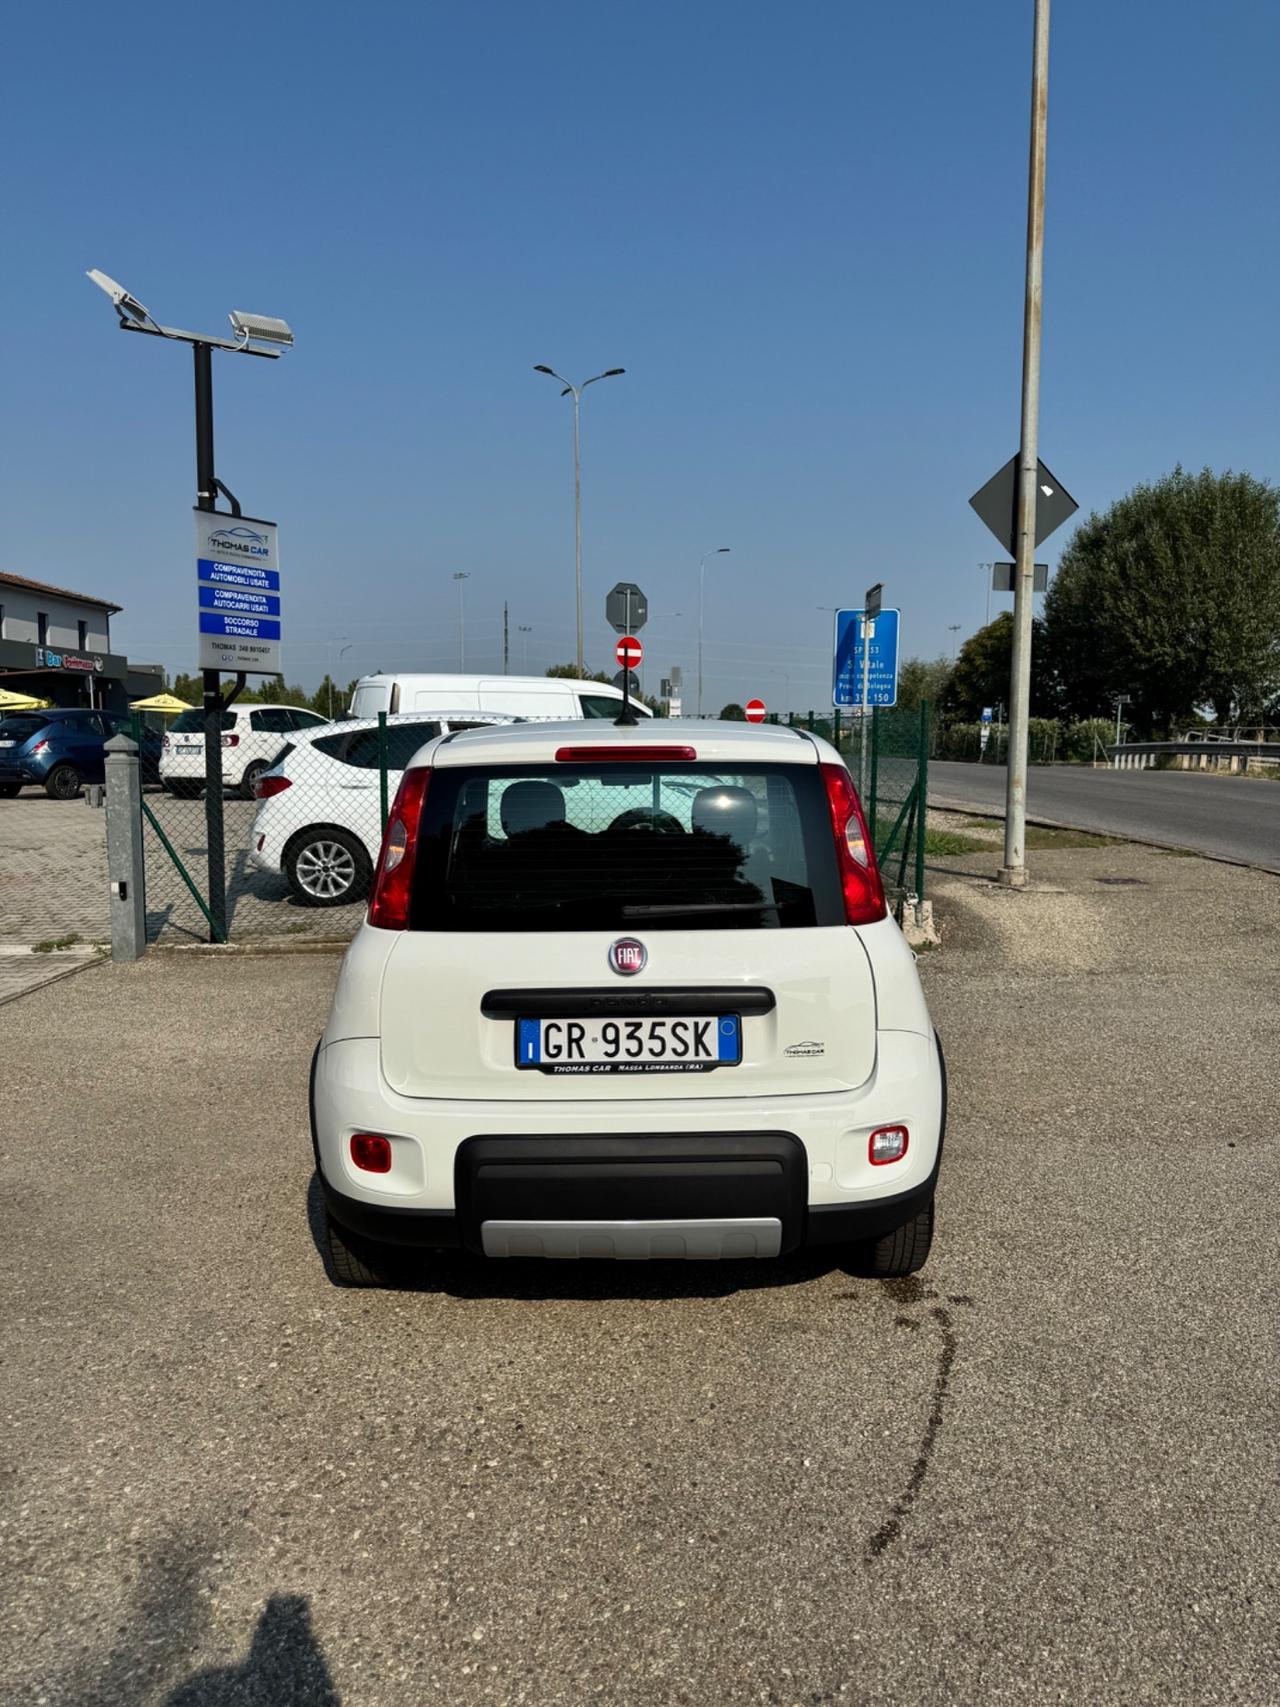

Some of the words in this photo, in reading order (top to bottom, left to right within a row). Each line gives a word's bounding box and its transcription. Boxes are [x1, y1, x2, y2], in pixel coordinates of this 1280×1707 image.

[211, 539, 249, 552] THOMAS
[250, 546, 269, 556] CAR
[213, 563, 266, 578] COMPRAVENDITA
[210, 572, 249, 585] AUTOMOBILI
[250, 579, 270, 588] USATE
[214, 590, 267, 604] COMPRAVENDITA
[213, 599, 250, 611] AUTOCARRI
[250, 604, 269, 613] USATI
[224, 616, 259, 628] SOCCORSO
[225, 625, 258, 636] STRADALE
[618, 948, 640, 964] FIAT
[544, 1022, 586, 1059] GR
[601, 1021, 713, 1059] 935SK
